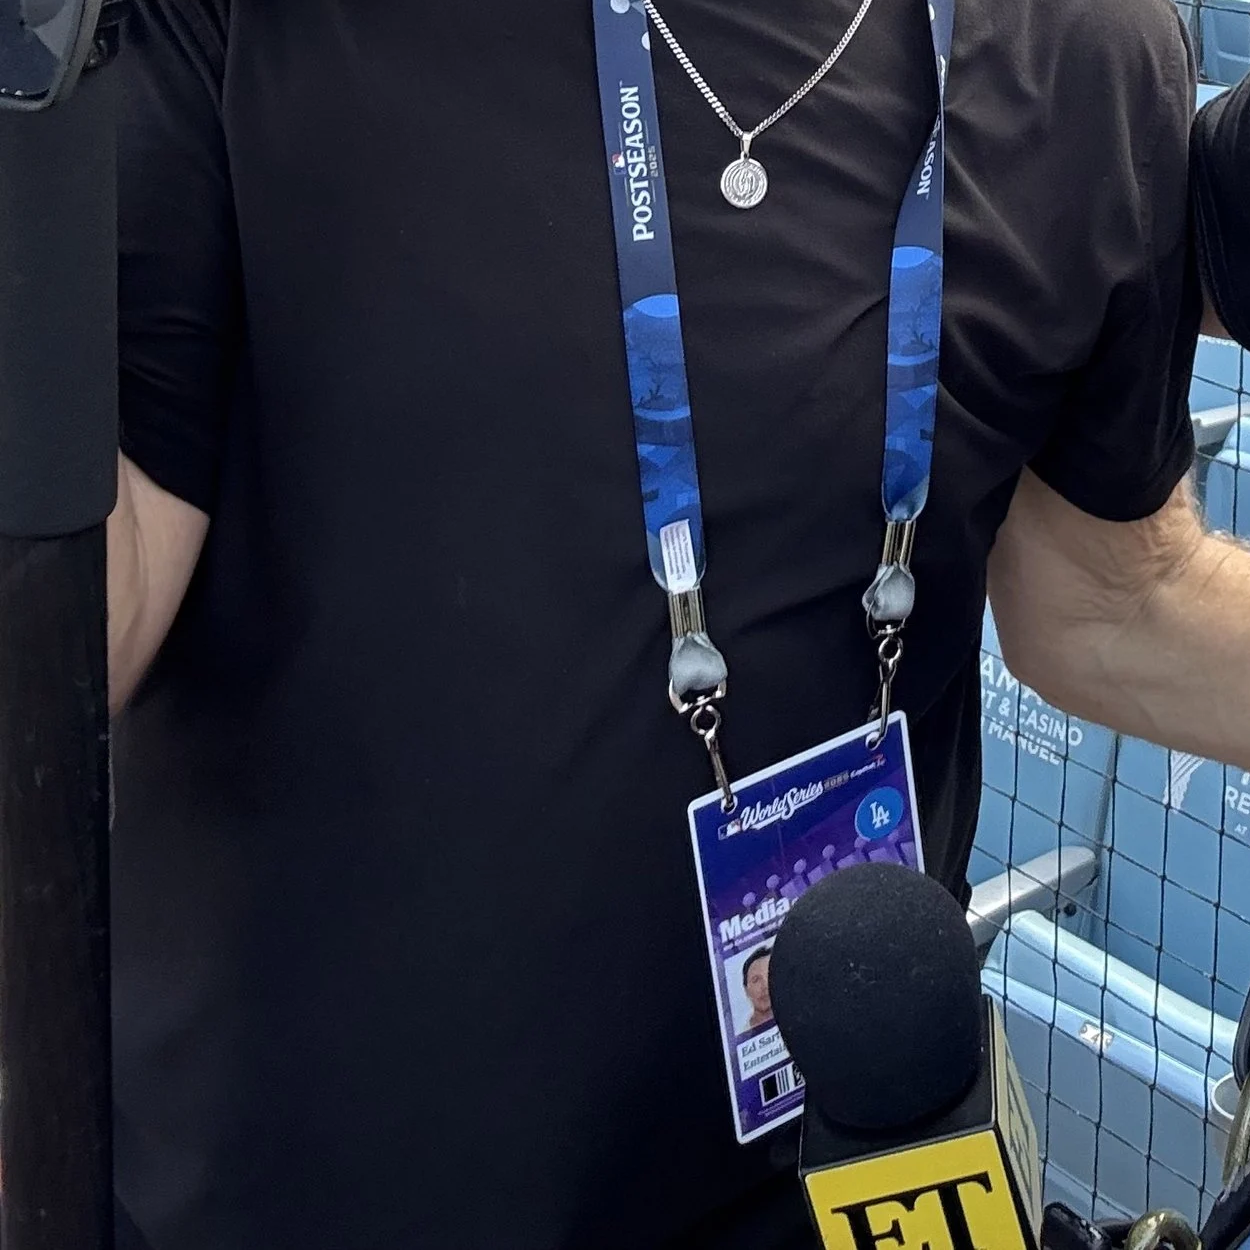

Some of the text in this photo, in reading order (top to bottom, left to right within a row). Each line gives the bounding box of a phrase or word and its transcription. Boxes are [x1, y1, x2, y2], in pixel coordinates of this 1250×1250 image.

[619, 85, 655, 242] POSTSEASON
[988, 717, 1060, 766] MANUEL
[998, 697, 1012, 717] &
[1015, 703, 1083, 747] CASINO
[869, 801, 890, 829] LA
[1234, 823, 1248, 836] AT
[719, 895, 791, 943] Media
[741, 1040, 757, 1058] Ed
[830, 1170, 993, 1250] ET
